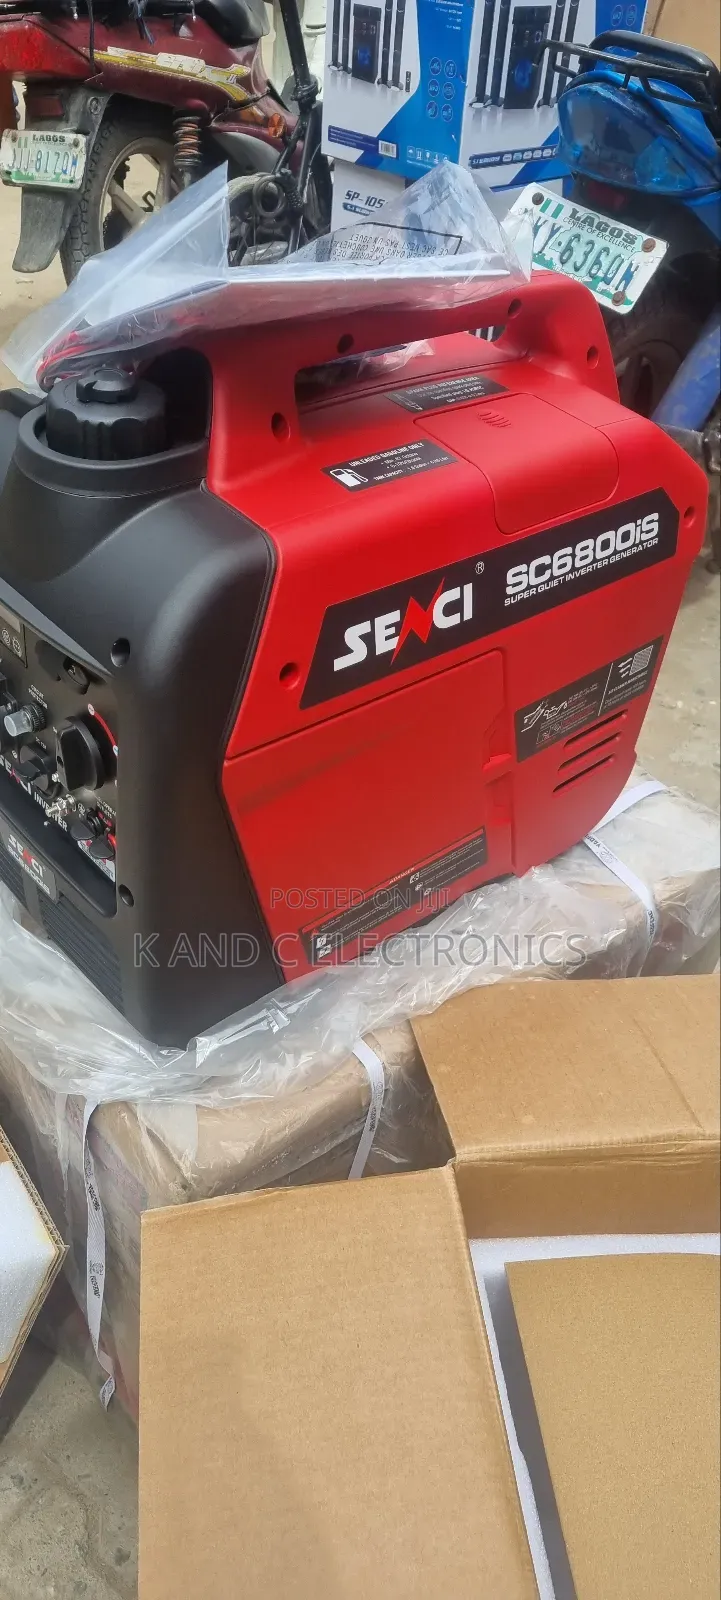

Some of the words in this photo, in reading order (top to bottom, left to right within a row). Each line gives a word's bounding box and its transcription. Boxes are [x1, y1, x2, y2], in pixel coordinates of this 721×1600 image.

[33, 134, 66, 142] LAGOS
[350, 234, 370, 243] JOUET
[385, 239, 398, 248] PAS
[563, 217, 586, 230] CENTRE
[596, 231, 635, 253] EXCELLENCE
[568, 208, 638, 245] LAGOS
[349, 453, 380, 467] UNLEADED
[380, 446, 409, 458] GASOLINE
[409, 442, 424, 451] ONLY
[504, 588, 536, 606] SUPER
[537, 576, 564, 593] QUIET
[565, 559, 608, 582] INVERTER
[609, 537, 659, 565] GENERATOR
[505, 513, 659, 596] SC6800iS
[333, 576, 473, 672] SENCI
